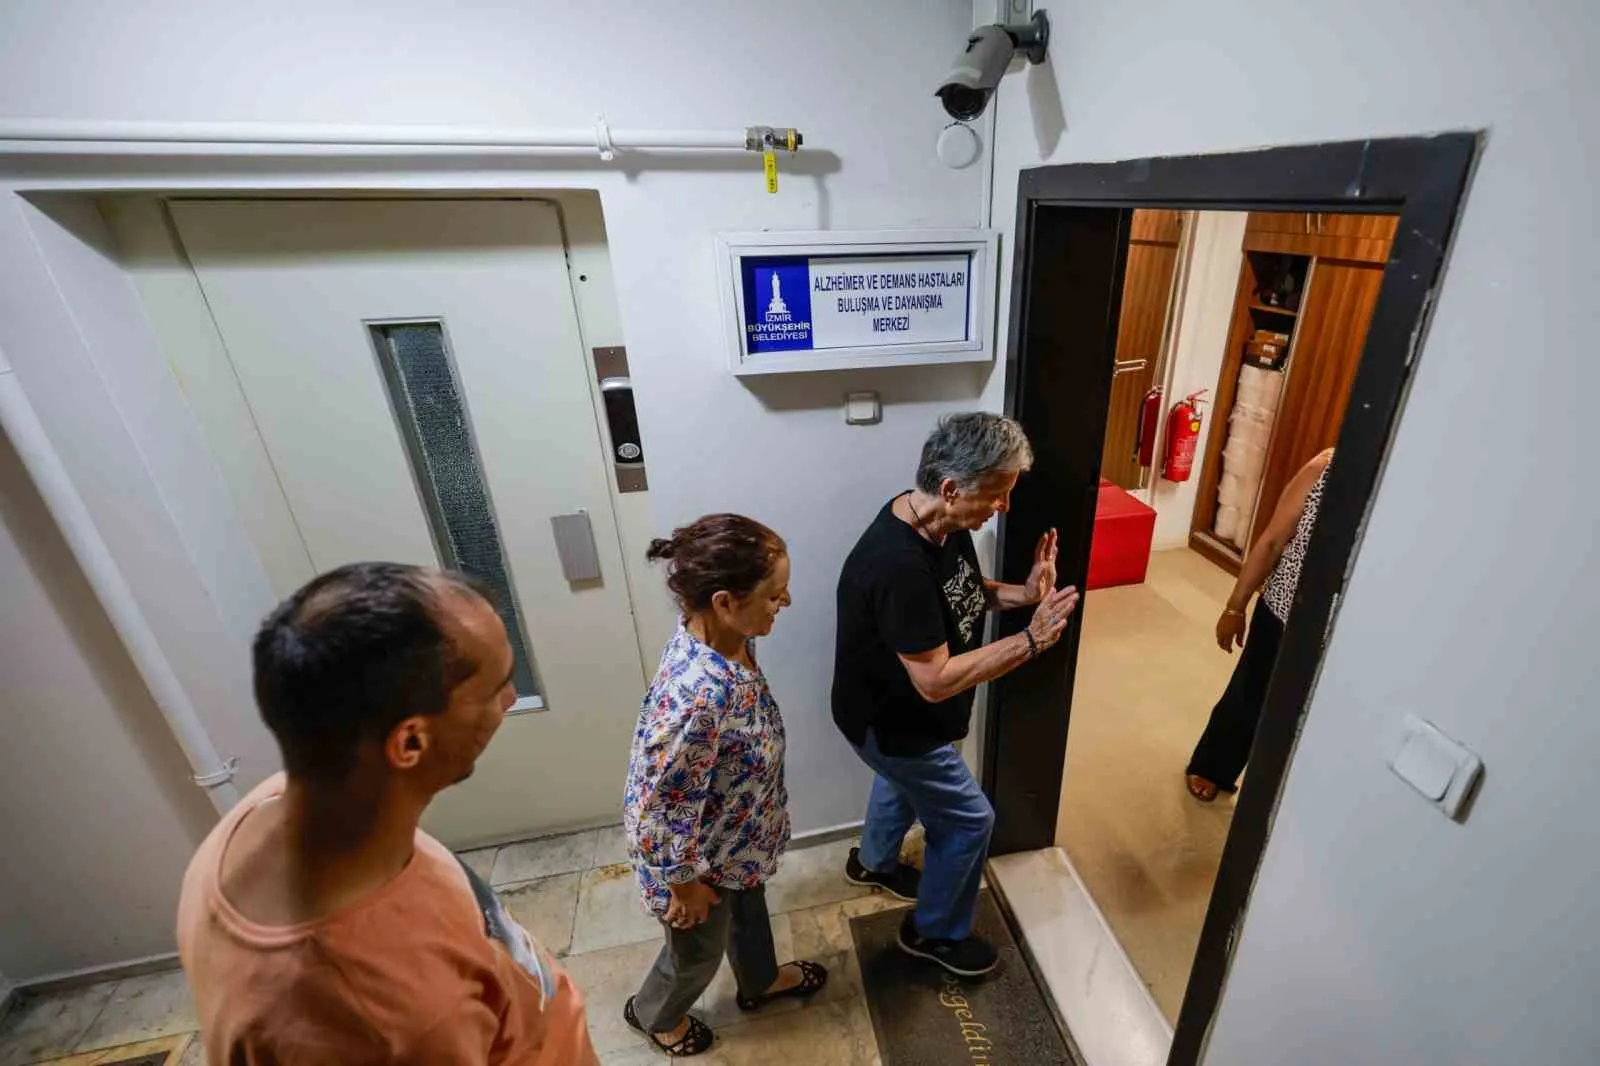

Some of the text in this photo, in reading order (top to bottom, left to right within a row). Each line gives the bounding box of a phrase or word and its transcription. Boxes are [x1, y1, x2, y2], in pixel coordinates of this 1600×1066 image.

[814, 271, 965, 292] ALZHEİMER VE DEMANS HASTALARI
[837, 294, 943, 314] BULUŞMA VE DAYANIŞMA
[873, 313, 910, 332] MERKEZİ
